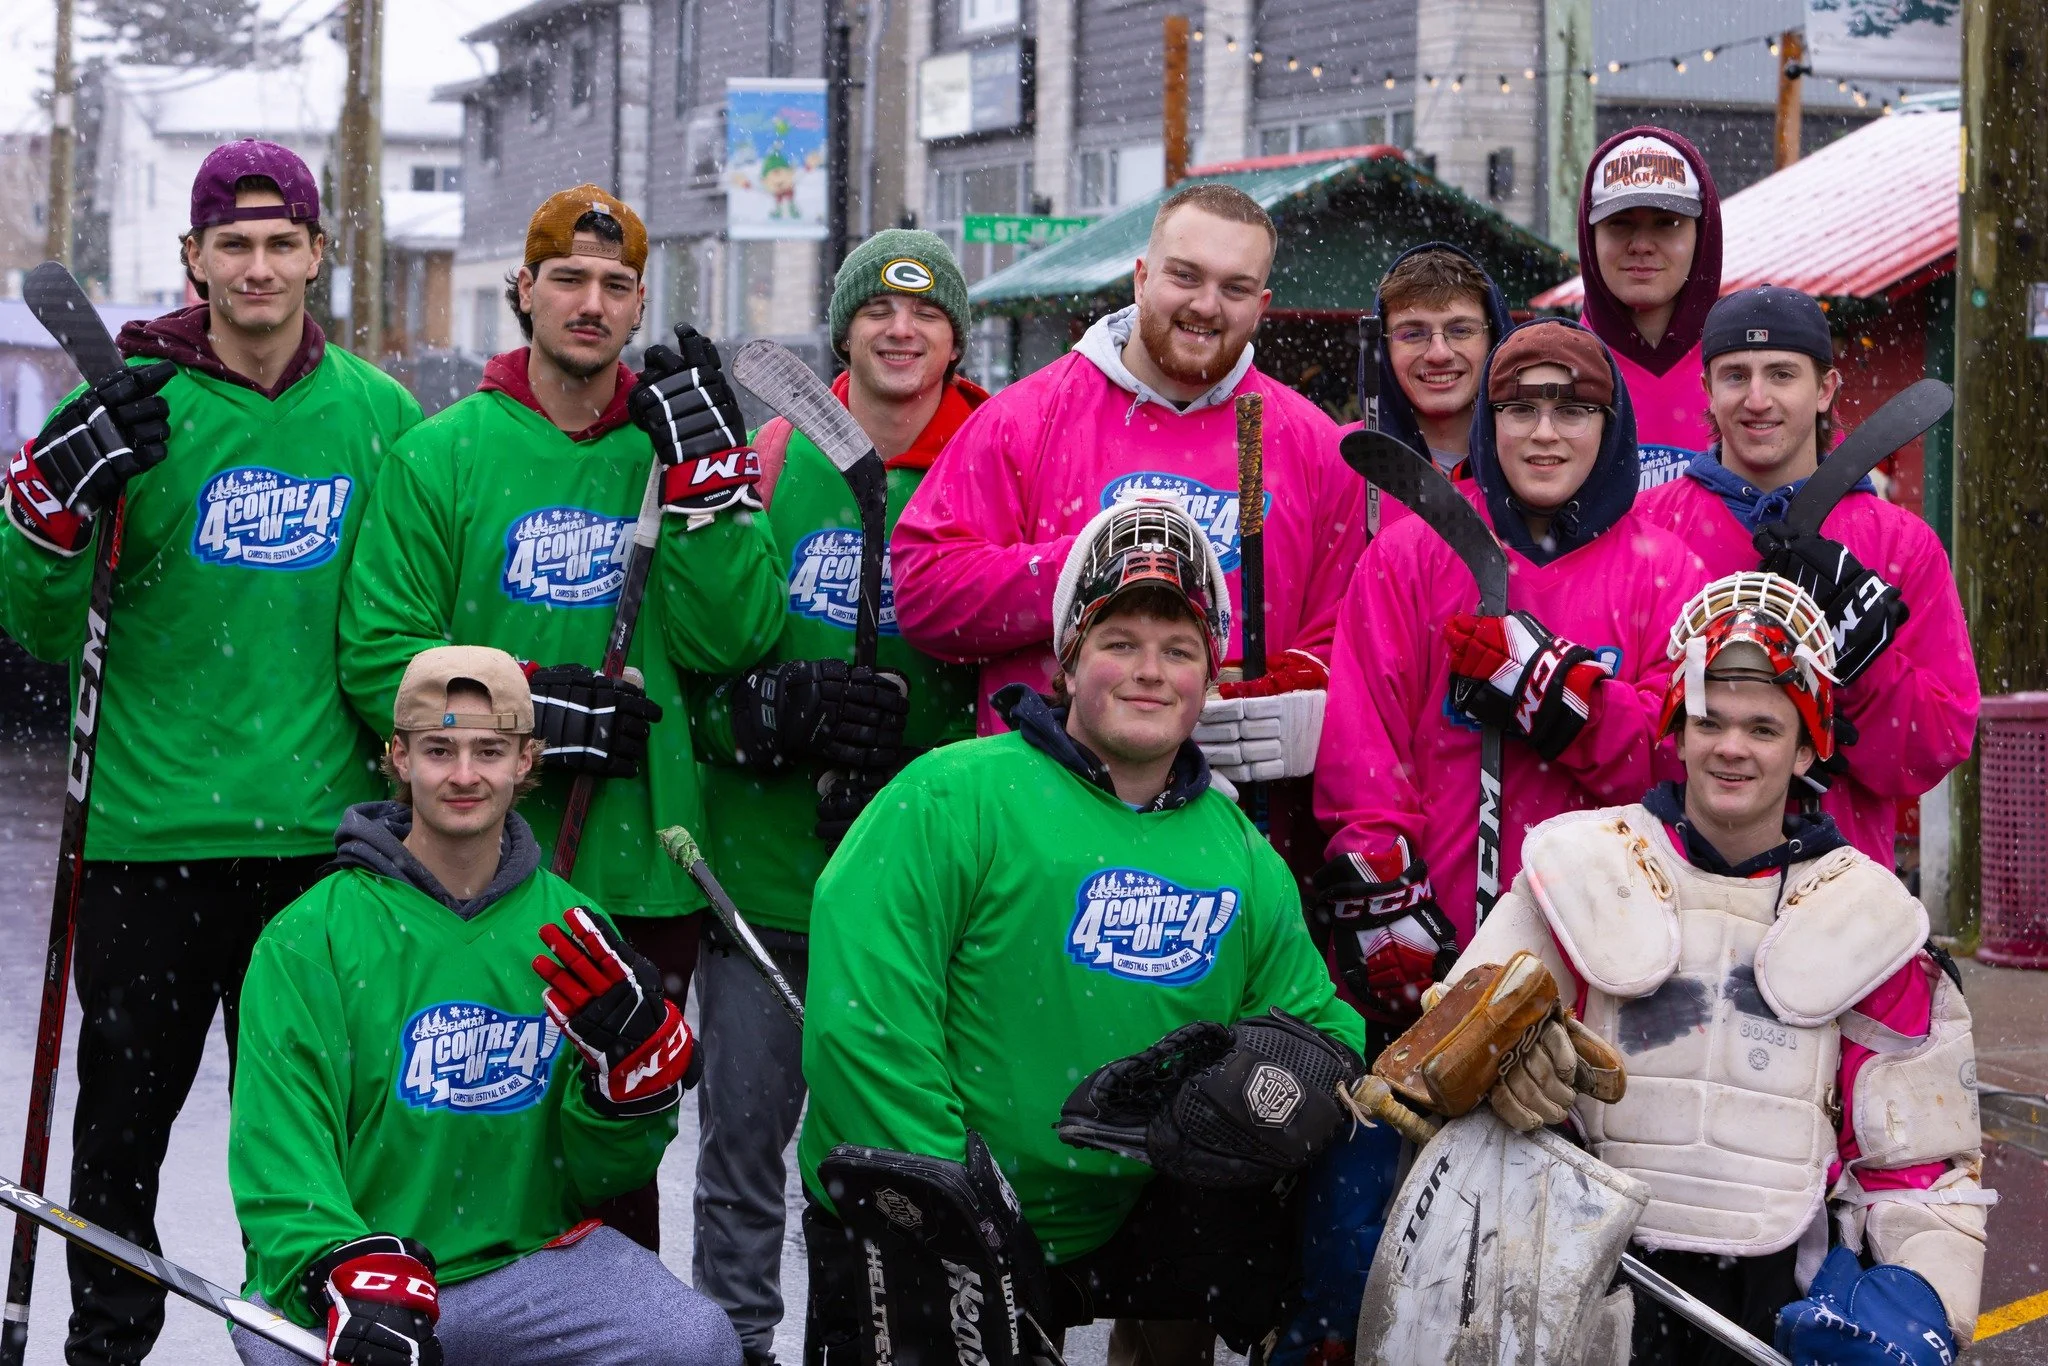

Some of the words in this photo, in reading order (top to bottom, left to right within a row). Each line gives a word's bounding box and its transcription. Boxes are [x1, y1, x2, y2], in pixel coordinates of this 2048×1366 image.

[1604, 154, 1686, 189] CHAMPIONS
[1622, 173, 1664, 186] GIANTS
[1667, 182, 1676, 190] 10
[1612, 184, 1622, 193] 20
[207, 479, 278, 503] CASSELMAN
[200, 499, 227, 552] 4
[228, 484, 310, 525] CONTRE
[304, 484, 331, 536] 4
[259, 513, 284, 542] ON
[515, 518, 586, 541] CASSELMAN
[507, 538, 535, 589] 4
[536, 522, 617, 563] CONTRE
[804, 545, 862, 556] CASSELM
[566, 551, 592, 581] ON
[789, 555, 823, 603] 4
[67, 606, 107, 803] CCM
[1087, 885, 1161, 900] CASSELMAN
[1335, 877, 1432, 918] CCM
[1072, 899, 1106, 954] 4
[1104, 894, 1192, 927] CONTRE
[1181, 896, 1216, 952] 4
[1132, 923, 1164, 951] ON
[412, 1014, 485, 1041] CASSELMAN
[1740, 1021, 1797, 1050] 80451
[405, 1038, 434, 1095] 4
[435, 1021, 518, 1064] CONTRE
[508, 1022, 539, 1078] 4
[464, 1051, 488, 1084] ON
[50, 1208, 88, 1229] PLUS
